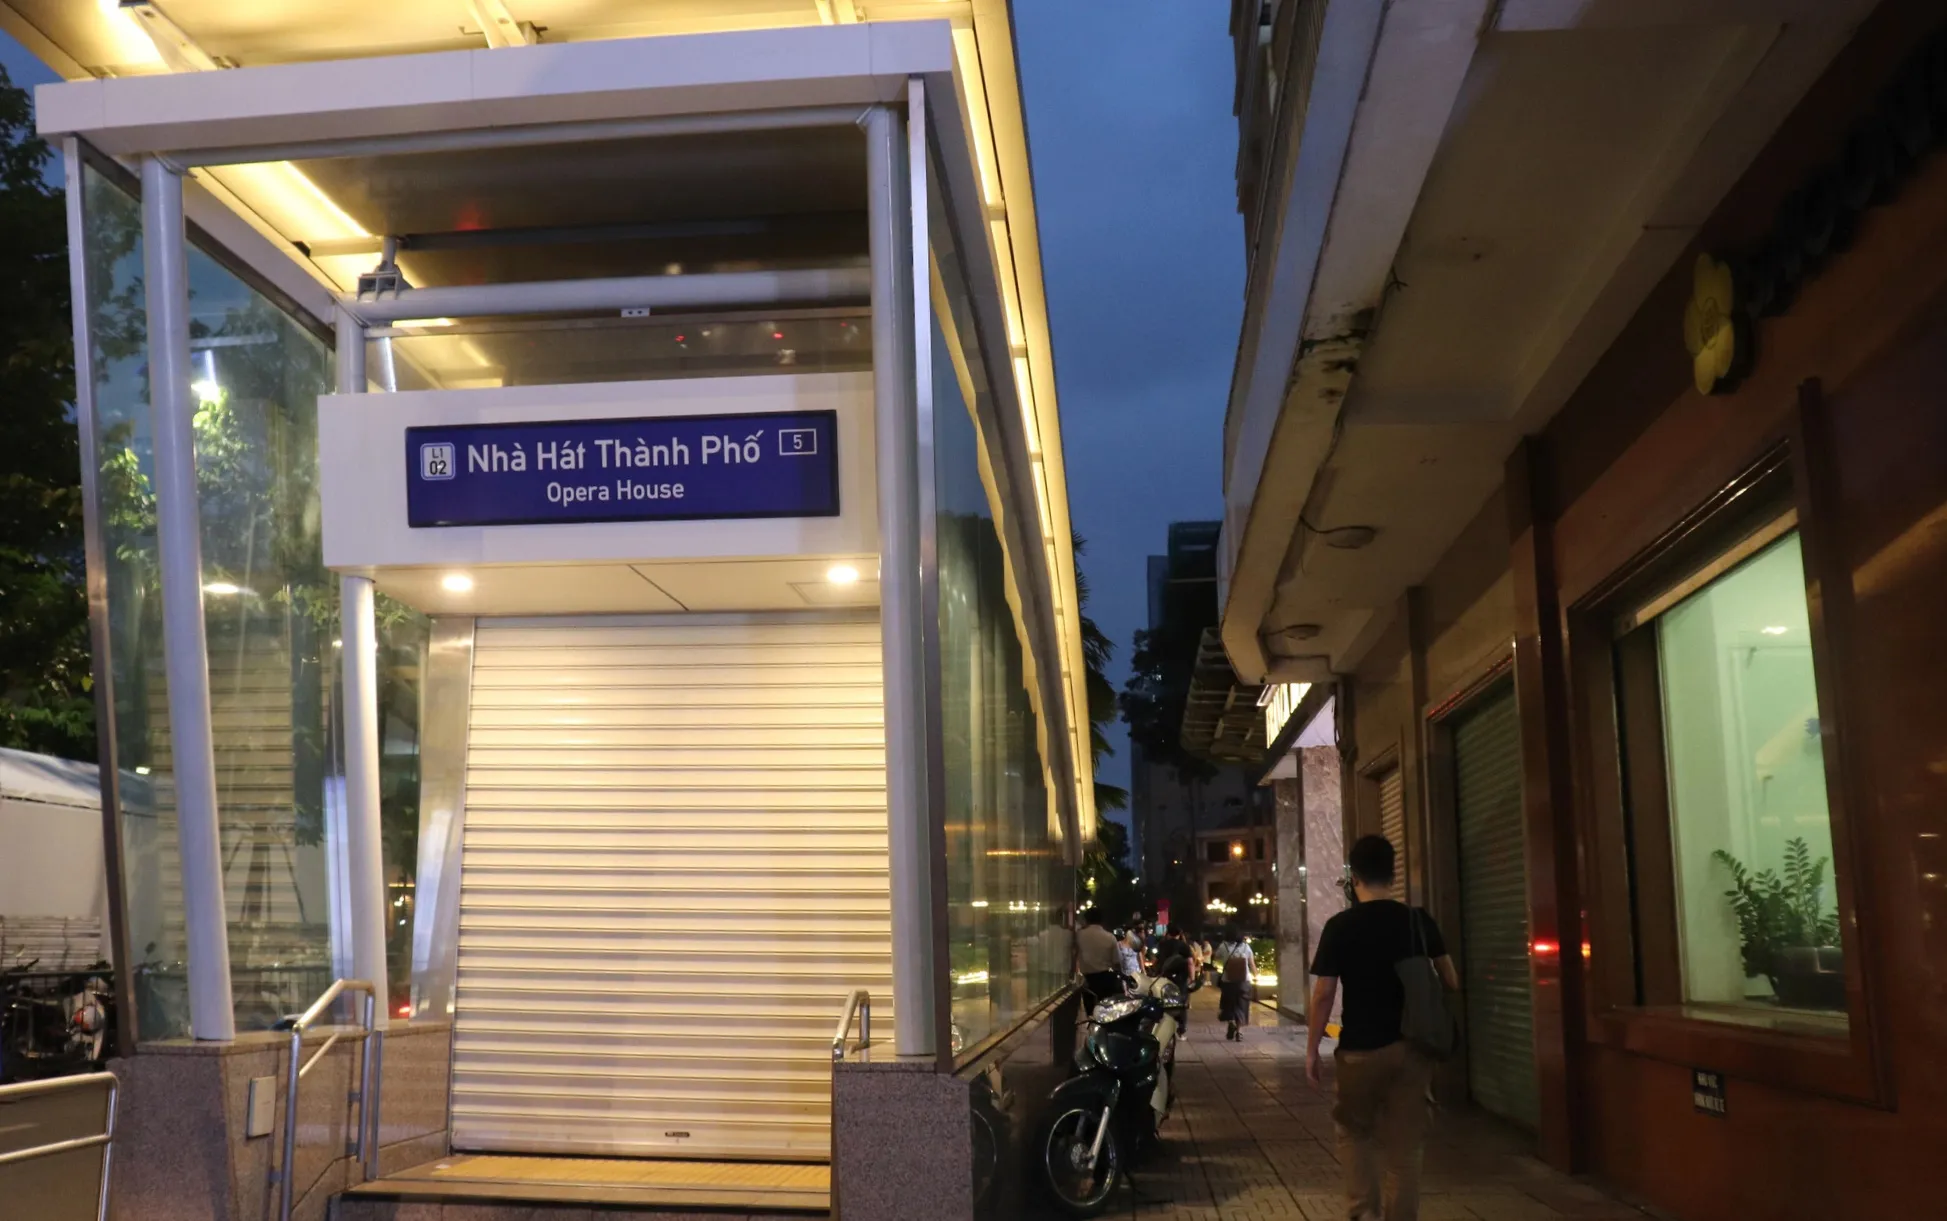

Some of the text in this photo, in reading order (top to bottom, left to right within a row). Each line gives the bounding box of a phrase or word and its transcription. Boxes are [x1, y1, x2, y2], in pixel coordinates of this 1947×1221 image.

[793, 434, 803, 450] 5
[431, 447, 444, 459] L1
[467, 430, 764, 473] Nhà Hát Thành Phố
[429, 460, 447, 475] 02
[546, 480, 685, 507] Opera House
